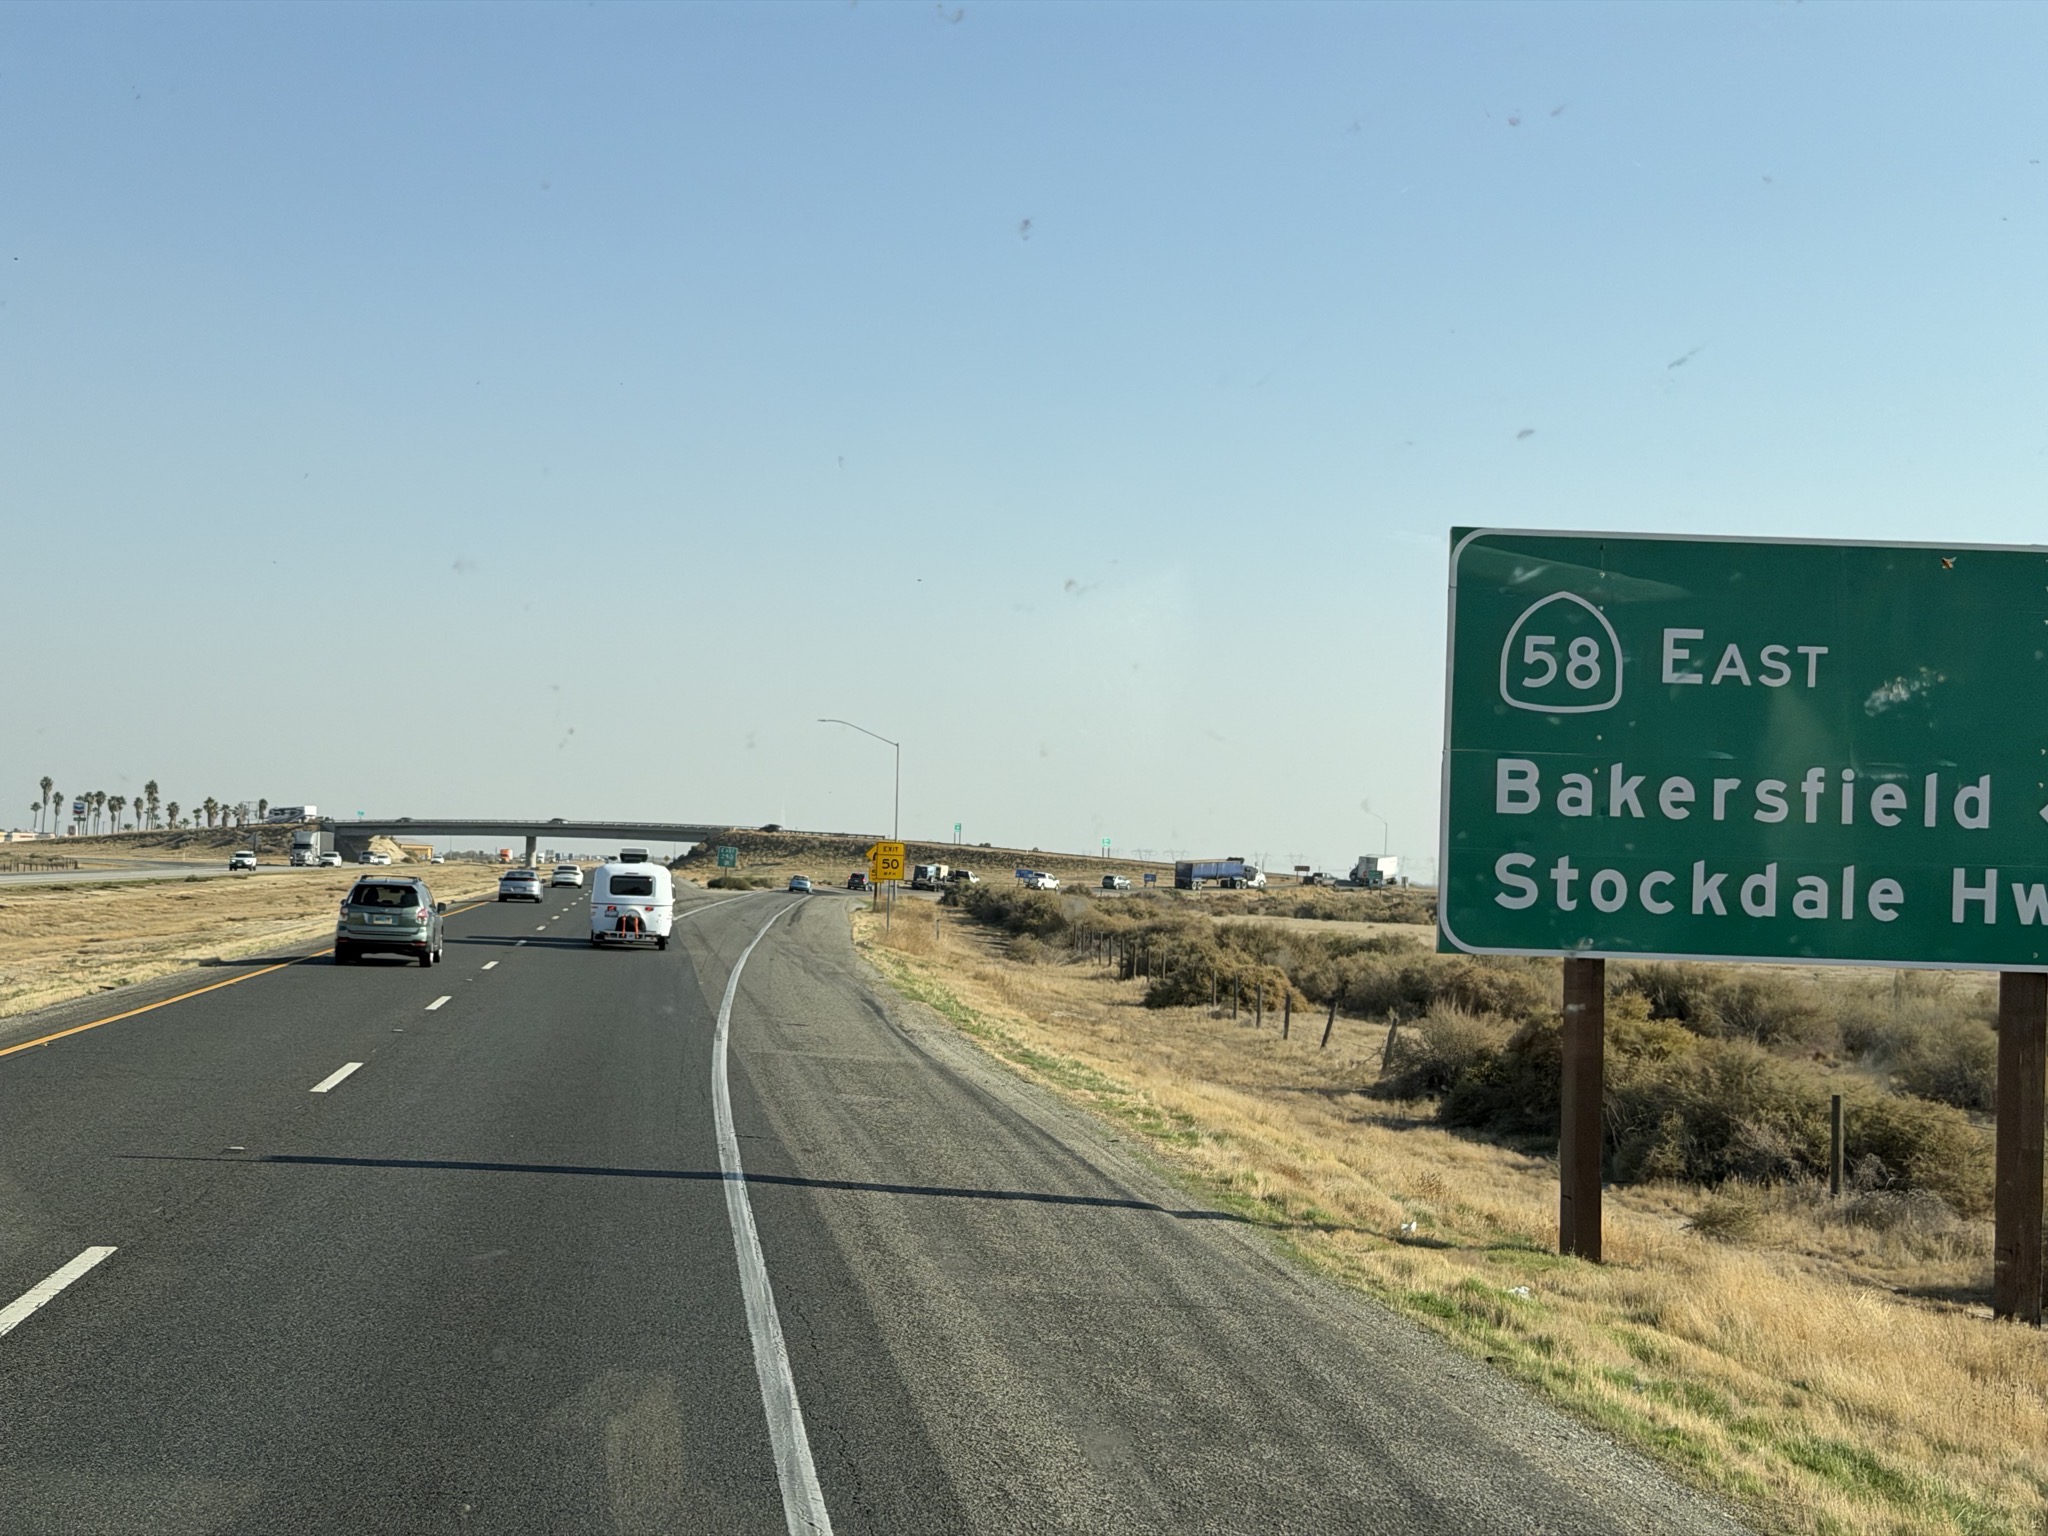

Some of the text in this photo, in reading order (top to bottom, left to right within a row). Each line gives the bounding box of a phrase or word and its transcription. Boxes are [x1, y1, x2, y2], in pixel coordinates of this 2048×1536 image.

[1521, 628, 1829, 690] 58 EAST
[1495, 758, 1990, 830] Bakersfield
[882, 858, 899, 870] 50
[1494, 852, 1905, 922] Stockdale
